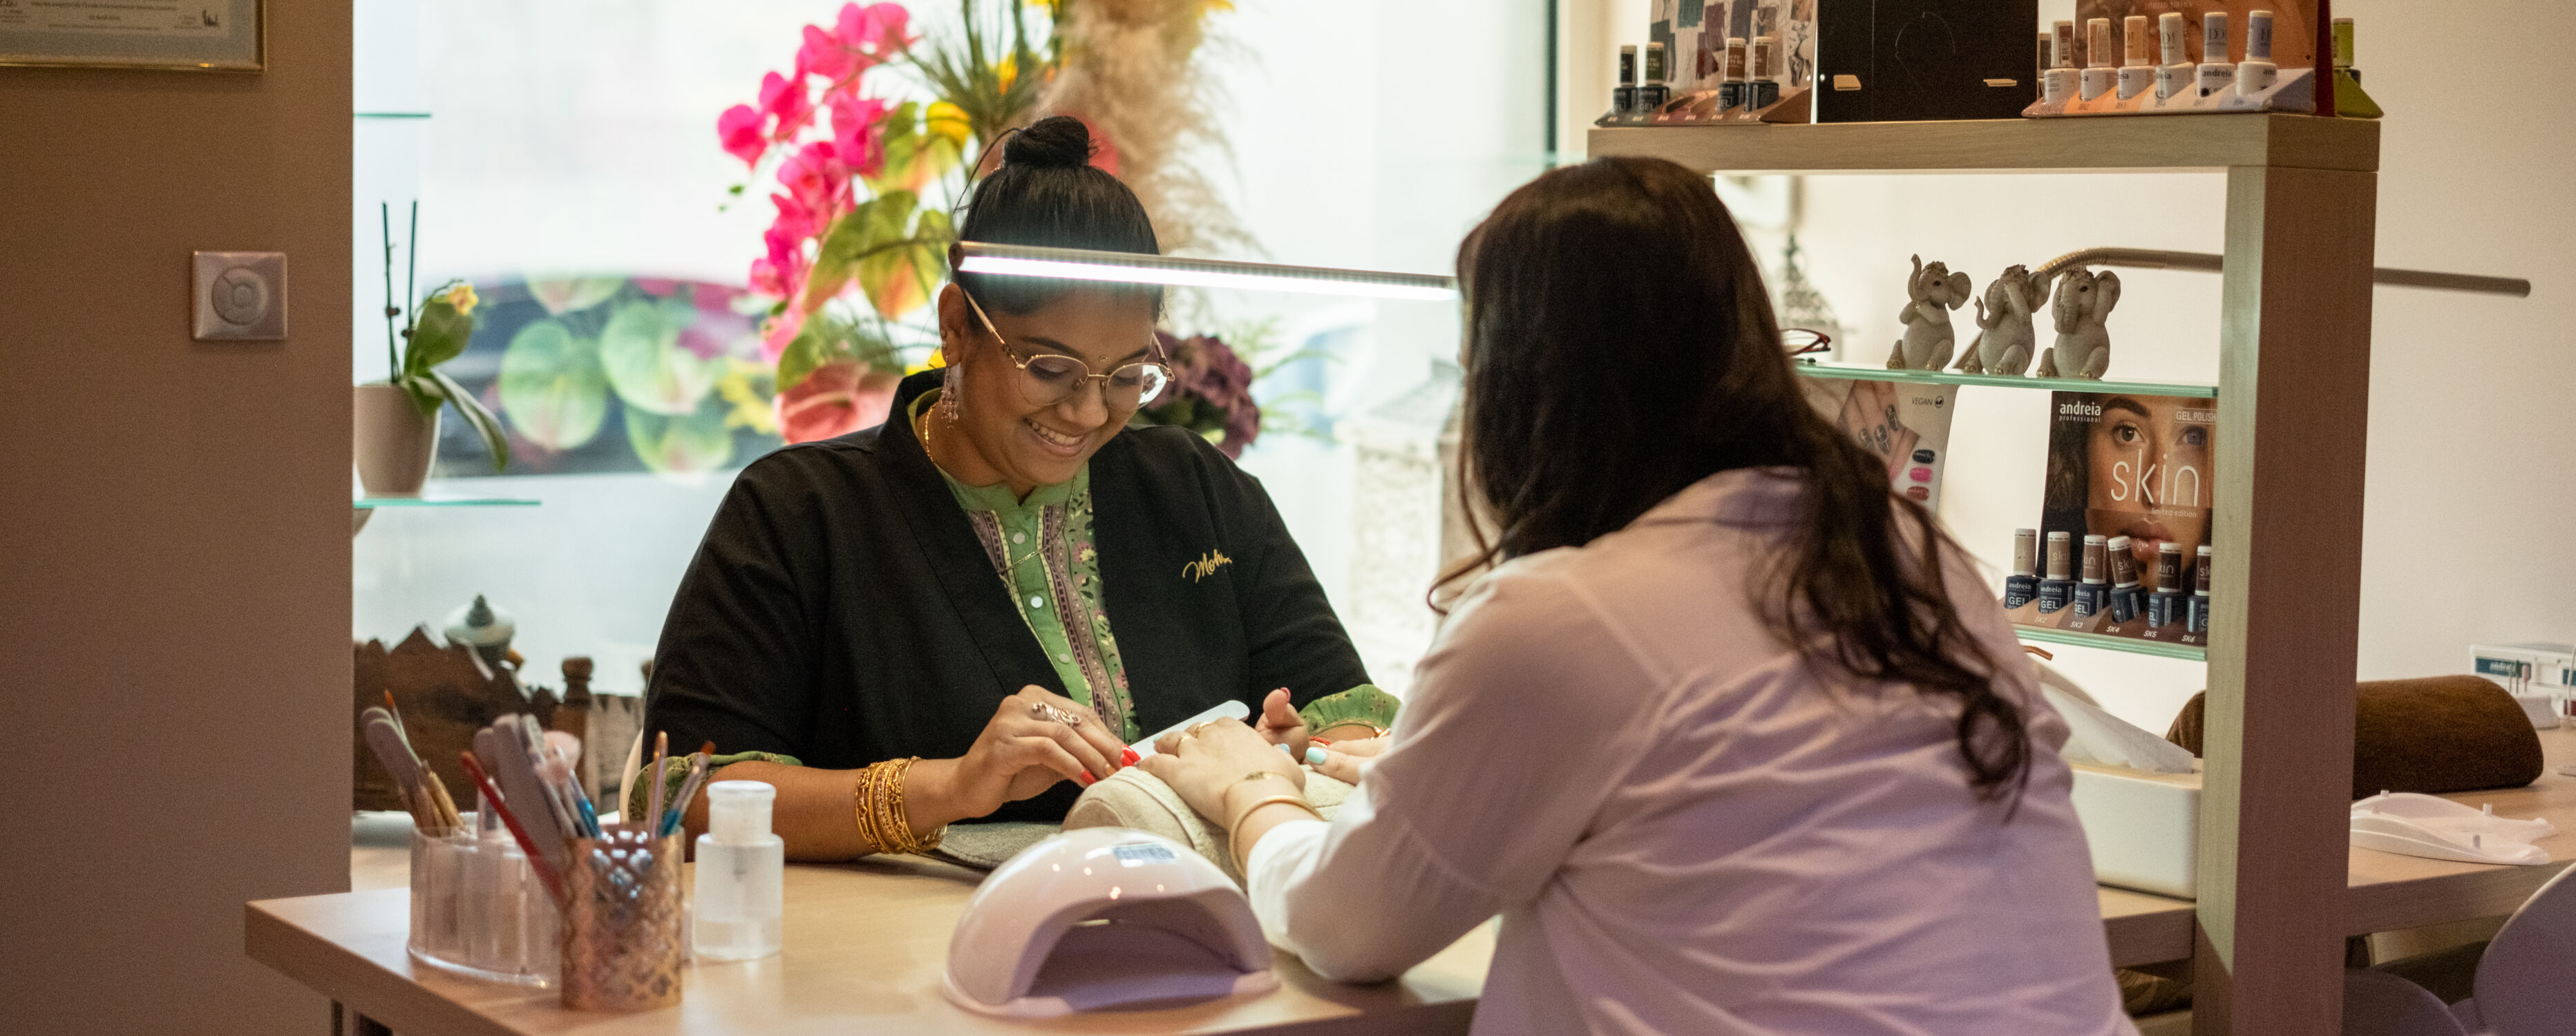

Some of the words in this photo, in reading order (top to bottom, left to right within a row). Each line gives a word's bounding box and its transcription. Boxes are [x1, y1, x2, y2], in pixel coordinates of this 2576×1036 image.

[2202, 68, 2232, 77] andreia
[1912, 397, 1933, 406] VEGAN
[2060, 401, 2101, 416] andreia
[2058, 414, 2101, 423] professional
[2176, 411, 2193, 421] GEL
[2193, 412, 2217, 422] POLISH
[2111, 448, 2199, 507] skin
[2151, 507, 2172, 516] limited
[2174, 510, 2197, 518] edition
[2040, 600, 2059, 609] GEL
[2143, 629, 2158, 637] SK5
[2181, 635, 2196, 643] SK6
